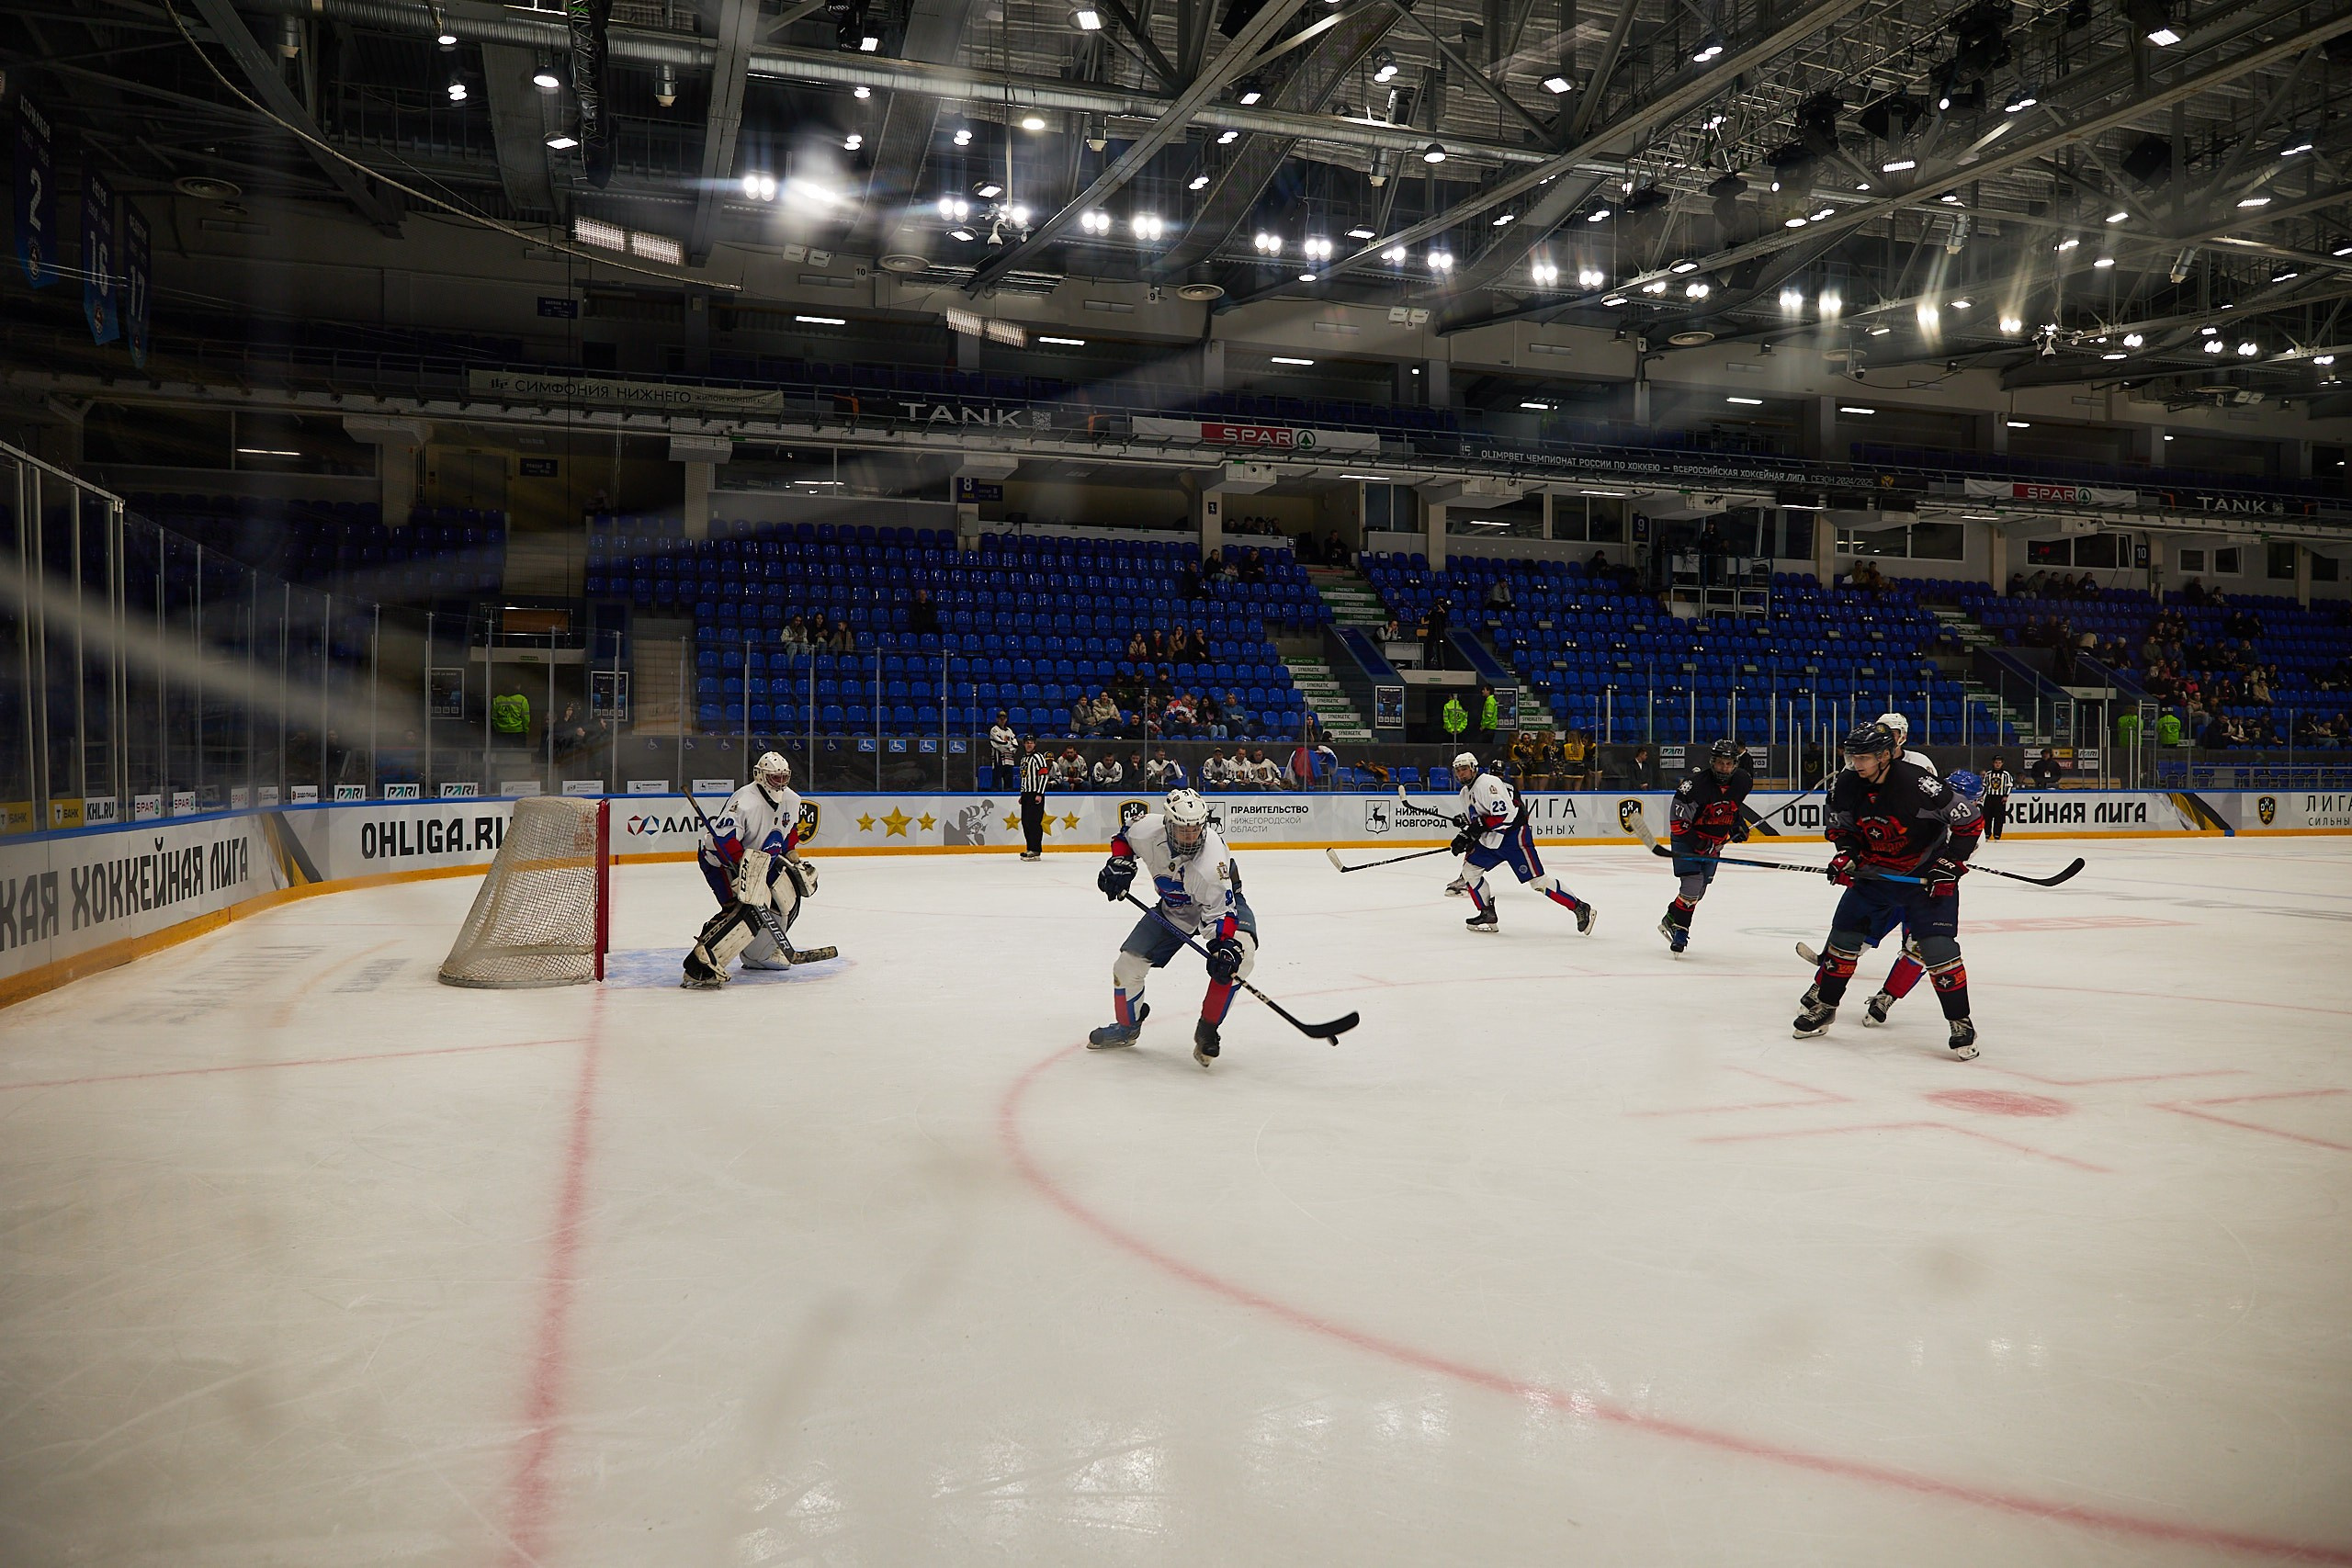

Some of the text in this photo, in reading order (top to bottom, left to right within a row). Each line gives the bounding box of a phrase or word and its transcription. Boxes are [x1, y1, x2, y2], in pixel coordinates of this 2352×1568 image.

[29, 167, 42, 232] 2
[90, 231, 108, 298] 16
[855, 267, 866, 276] 10
[130, 264, 145, 321] 17
[514, 379, 608, 398] СИМФОНИЯ
[616, 388, 691, 403] НИЖНЕГО
[899, 401, 1023, 429] TANK
[1223, 428, 1292, 446] SPAR
[1481, 449, 1524, 462] OLIMPBET
[1526, 453, 1577, 467] ЧЕМПИОНАТ
[1579, 457, 1611, 469] РОССИИ
[1613, 460, 1625, 470] ПО
[1627, 462, 1660, 472] ХОККЕЮ
[1673, 464, 1738, 478] ВСЕРОССИЙСКАЯ
[1740, 468, 1785, 482] ХОККЕЙНАЯ
[1786, 472, 1806, 483] ЛИГА
[1811, 474, 1835, 484] СЕЗОН
[1837, 476, 1874, 488] 2024/2025
[964, 477, 973, 491] 8
[2027, 487, 2075, 502] SPAR
[2196, 496, 2268, 514] TANK
[1638, 518, 1645, 532] 9
[2137, 547, 2147, 559] 10
[336, 788, 364, 800] PARI
[387, 786, 416, 798] PARI
[443, 784, 475, 796] PARI
[136, 801, 153, 813] SPAR
[175, 796, 192, 809] SPAR
[1492, 800, 1507, 812] 23
[63, 808, 79, 818] БАНК
[86, 801, 115, 820] KHL.RU
[1231, 806, 1309, 814] ПРАВИТЕЛЬСТВО
[1396, 806, 1439, 816] НИЖНИЙ
[1675, 804, 1685, 818] 77
[1950, 802, 1972, 821] 33
[2094, 802, 2146, 823] ЛИГА
[1231, 816, 1302, 825] НИЖЕГОРОДСКОЙ
[1396, 818, 1448, 829] НОВГОРОД
[1531, 825, 1575, 835] ЬНЫХ
[741, 858, 750, 893] CCM
[71, 837, 204, 931] ХОККЕЙНАЯ
[210, 837, 248, 892] ЛИГА
